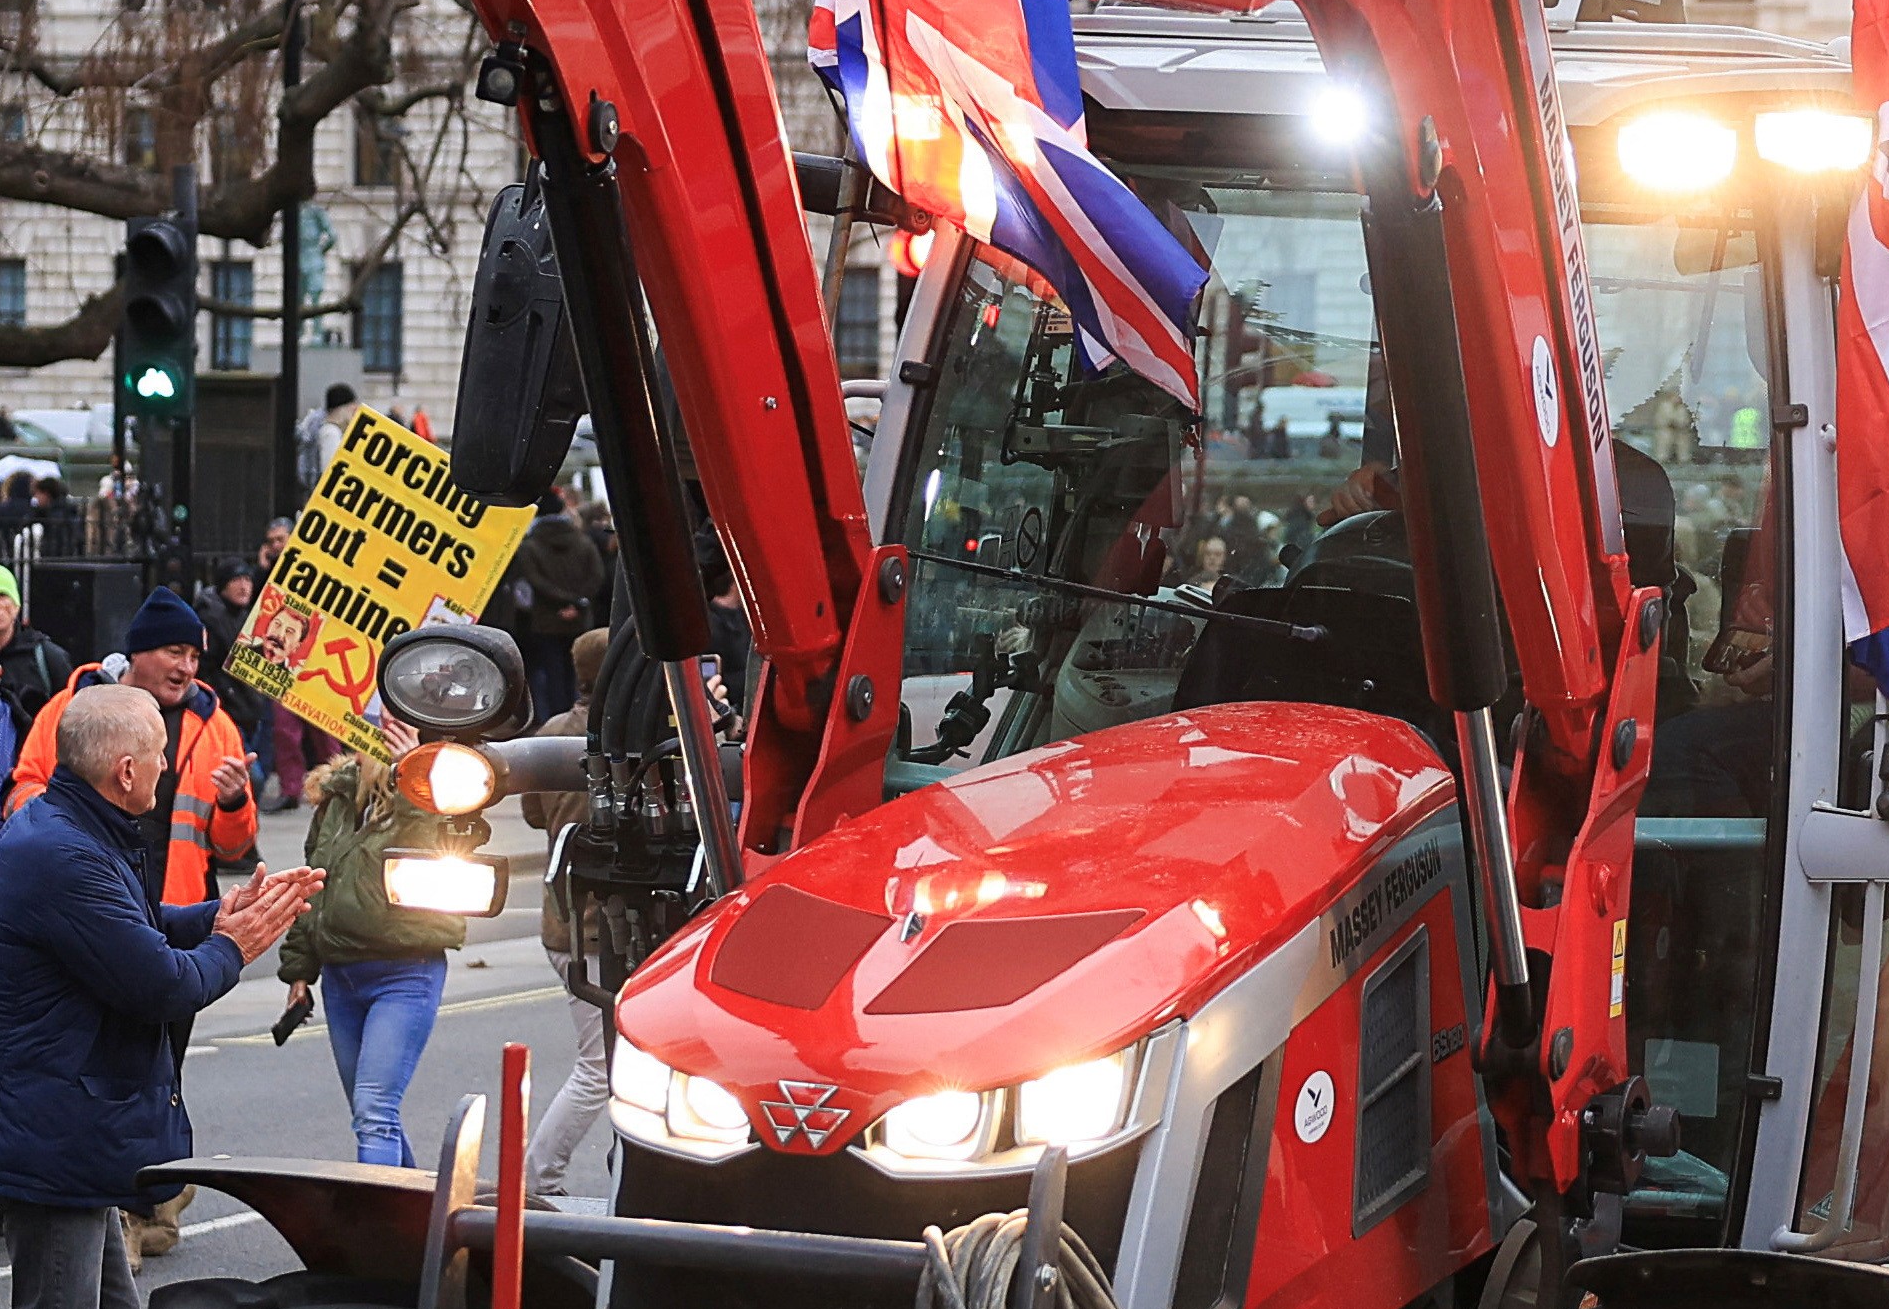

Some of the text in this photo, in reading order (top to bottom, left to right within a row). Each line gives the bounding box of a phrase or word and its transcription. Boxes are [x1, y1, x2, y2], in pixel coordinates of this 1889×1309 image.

[1540, 73, 1605, 454] MASSEY FERGUSON
[343, 413, 488, 529] Forcing
[298, 509, 367, 569] out
[320, 460, 475, 579] farmers
[272, 548, 411, 645] famine
[284, 594, 312, 616] Stalin
[233, 643, 295, 689] USSR 1930s
[255, 672, 281, 697] dead
[283, 691, 347, 738] STARVATION
[1330, 836, 1442, 969] MASSEY FERGUSON
